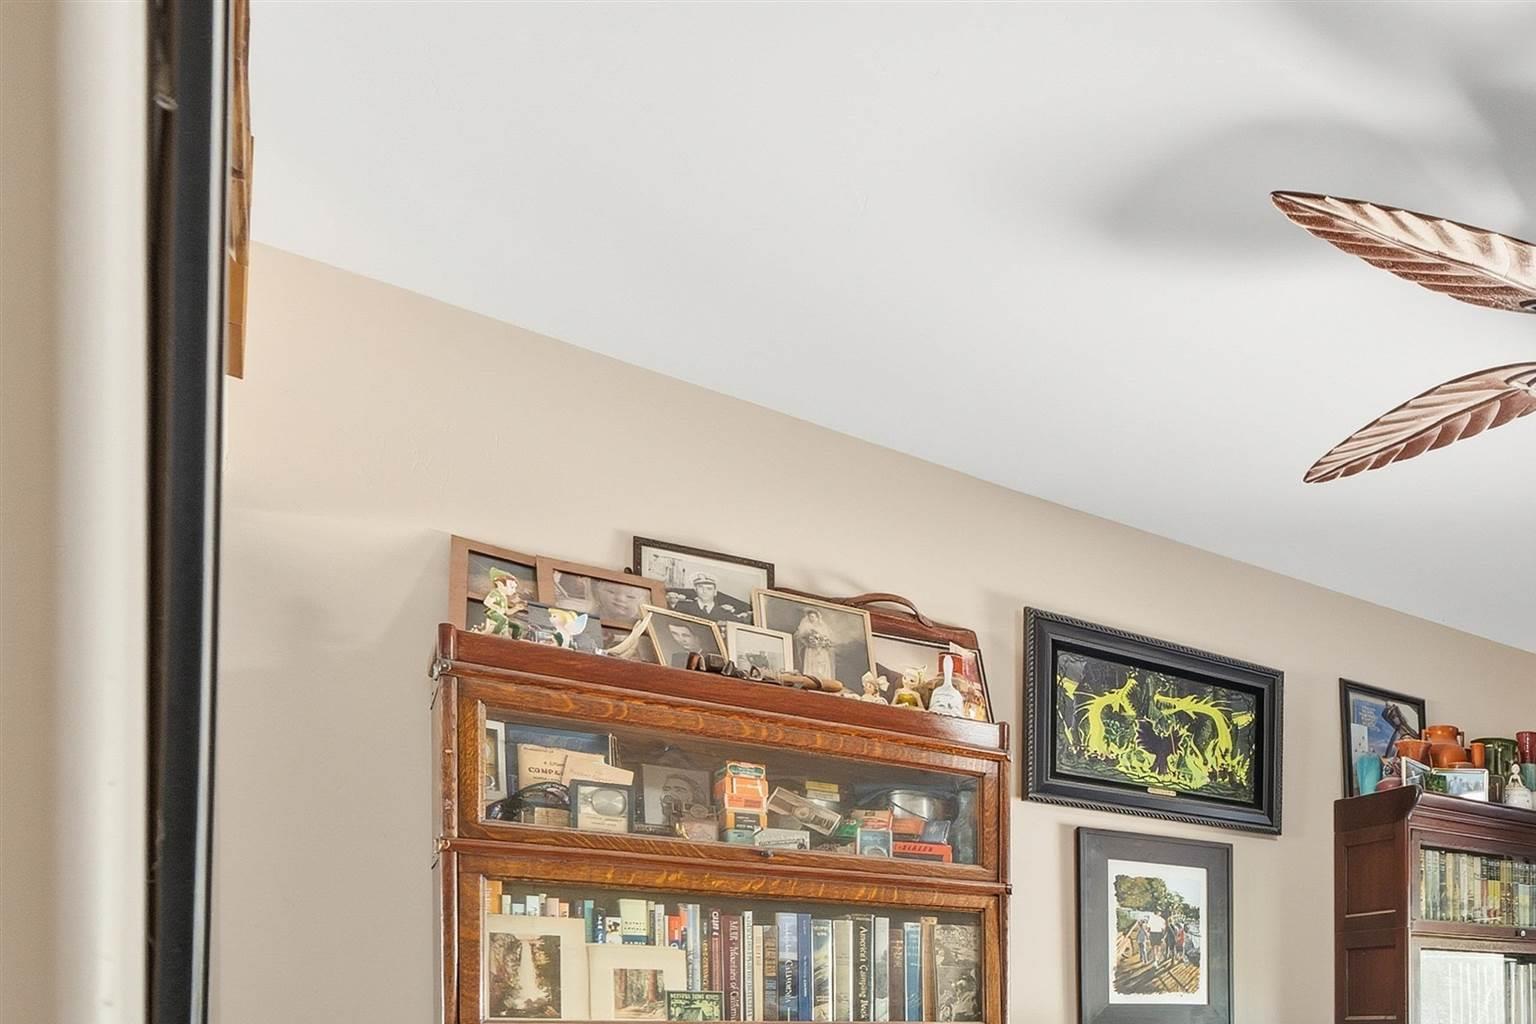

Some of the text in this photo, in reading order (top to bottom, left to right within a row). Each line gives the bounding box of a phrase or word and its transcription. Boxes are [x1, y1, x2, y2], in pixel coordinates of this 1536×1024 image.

[729, 920, 738, 940] MUIR
[859, 926, 868, 961] America's
[729, 947, 739, 980] Mountains
[859, 964, 868, 998] Camping
